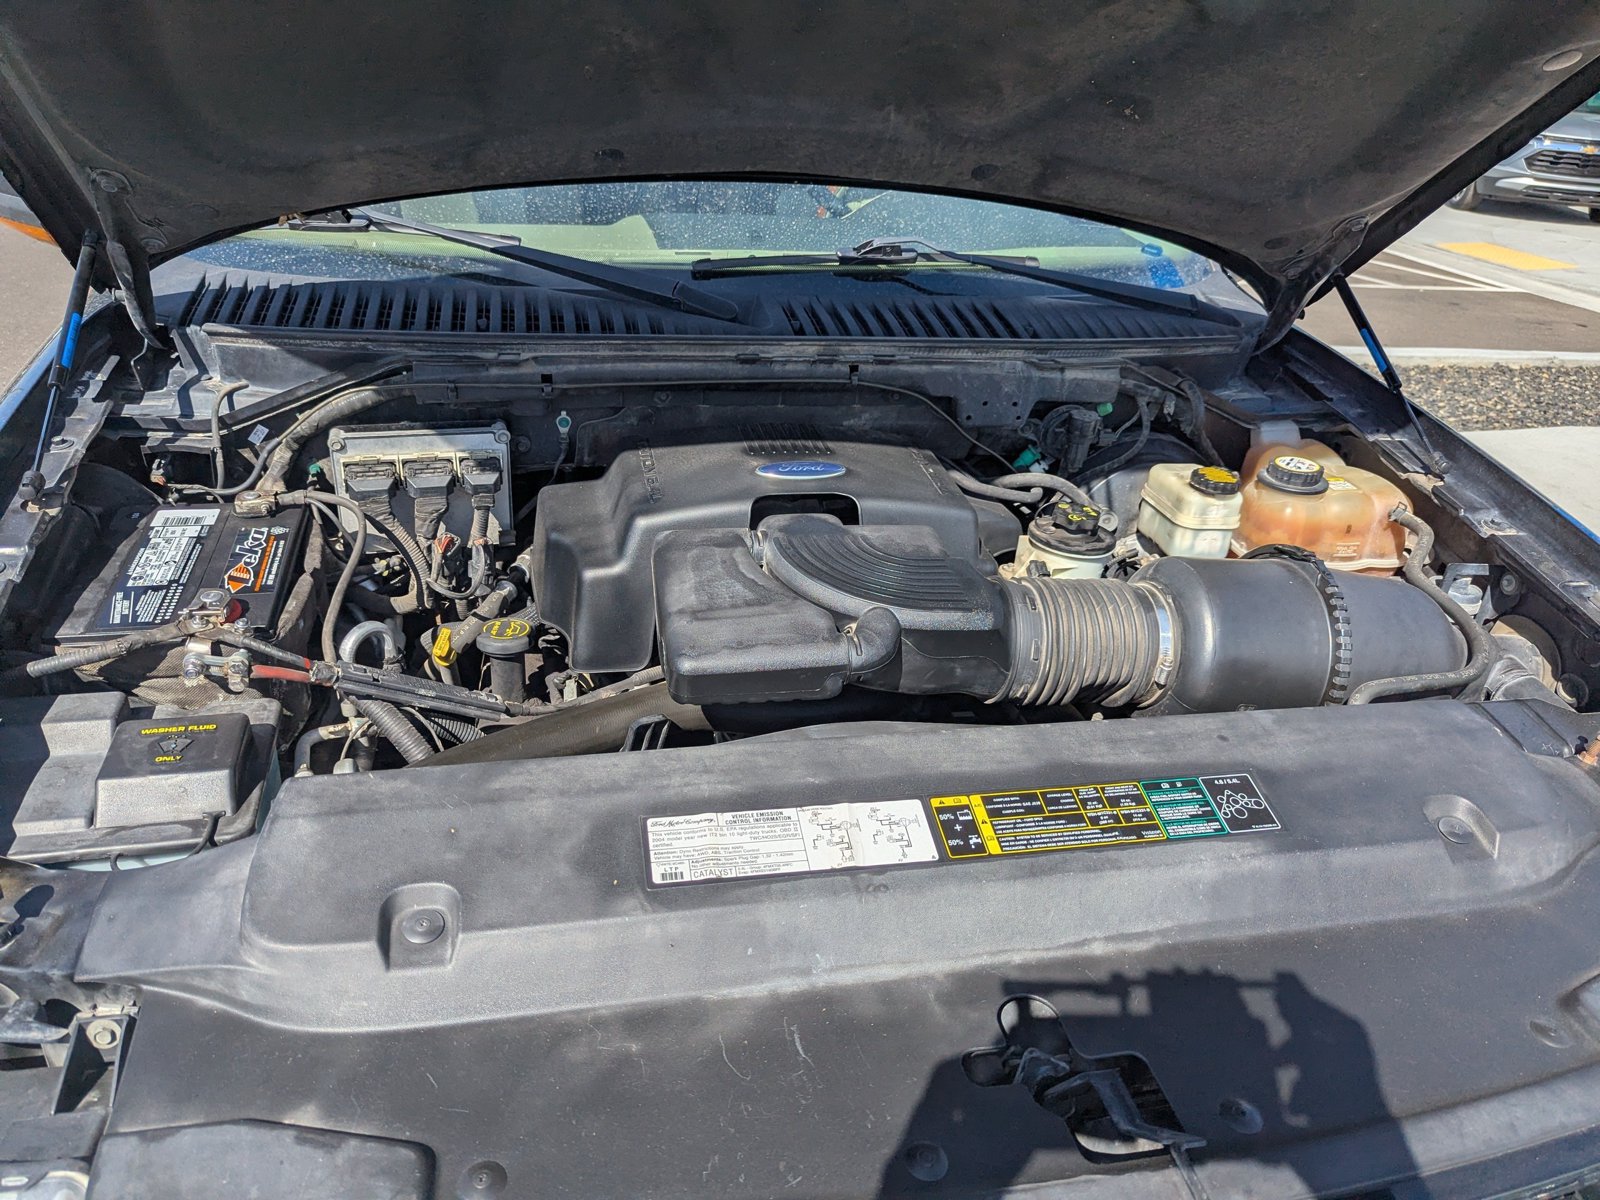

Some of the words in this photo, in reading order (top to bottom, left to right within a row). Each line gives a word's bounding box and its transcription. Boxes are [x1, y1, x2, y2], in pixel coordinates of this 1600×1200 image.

[778, 462, 825, 472] Ford
[224, 527, 268, 593] Deka
[141, 726, 186, 735] WASHER
[948, 838, 964, 846] 50%
[694, 868, 734, 878] CATALYST
